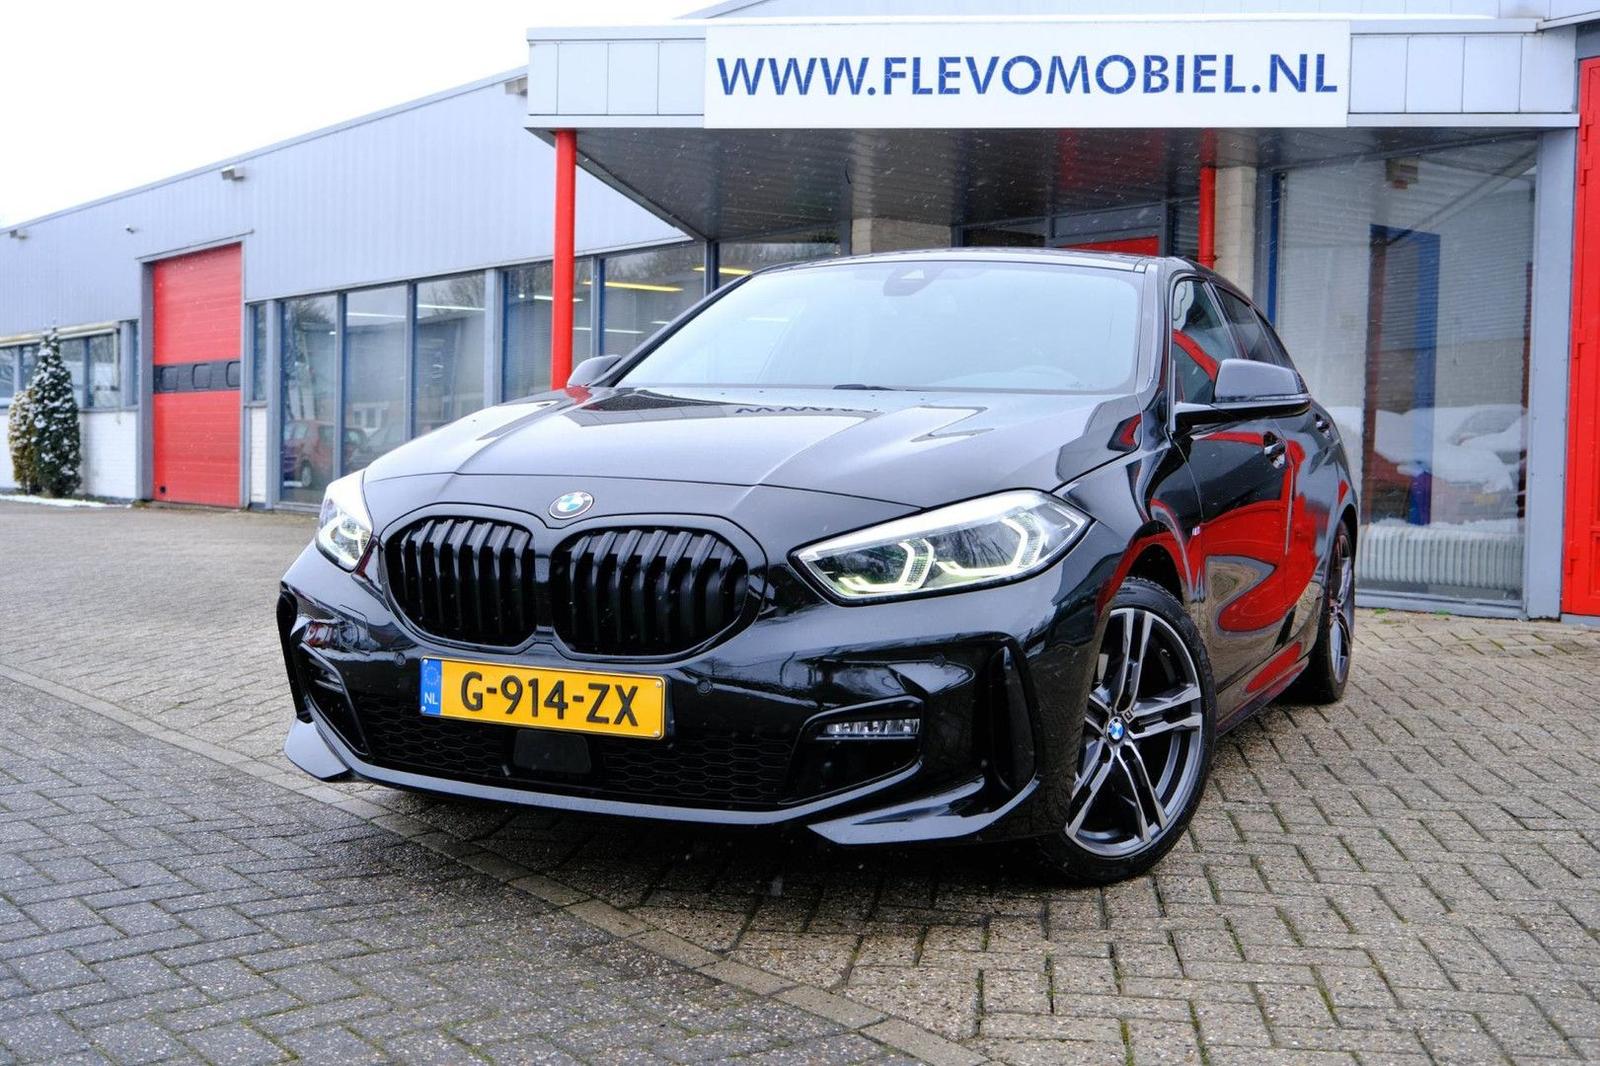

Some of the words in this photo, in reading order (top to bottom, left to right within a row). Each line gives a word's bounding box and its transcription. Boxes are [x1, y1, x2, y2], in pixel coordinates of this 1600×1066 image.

[716, 53, 1338, 96] WWW.FLEVOMOBIEL.NL
[424, 692, 438, 705] NL
[461, 671, 639, 726] G-914-ZX
